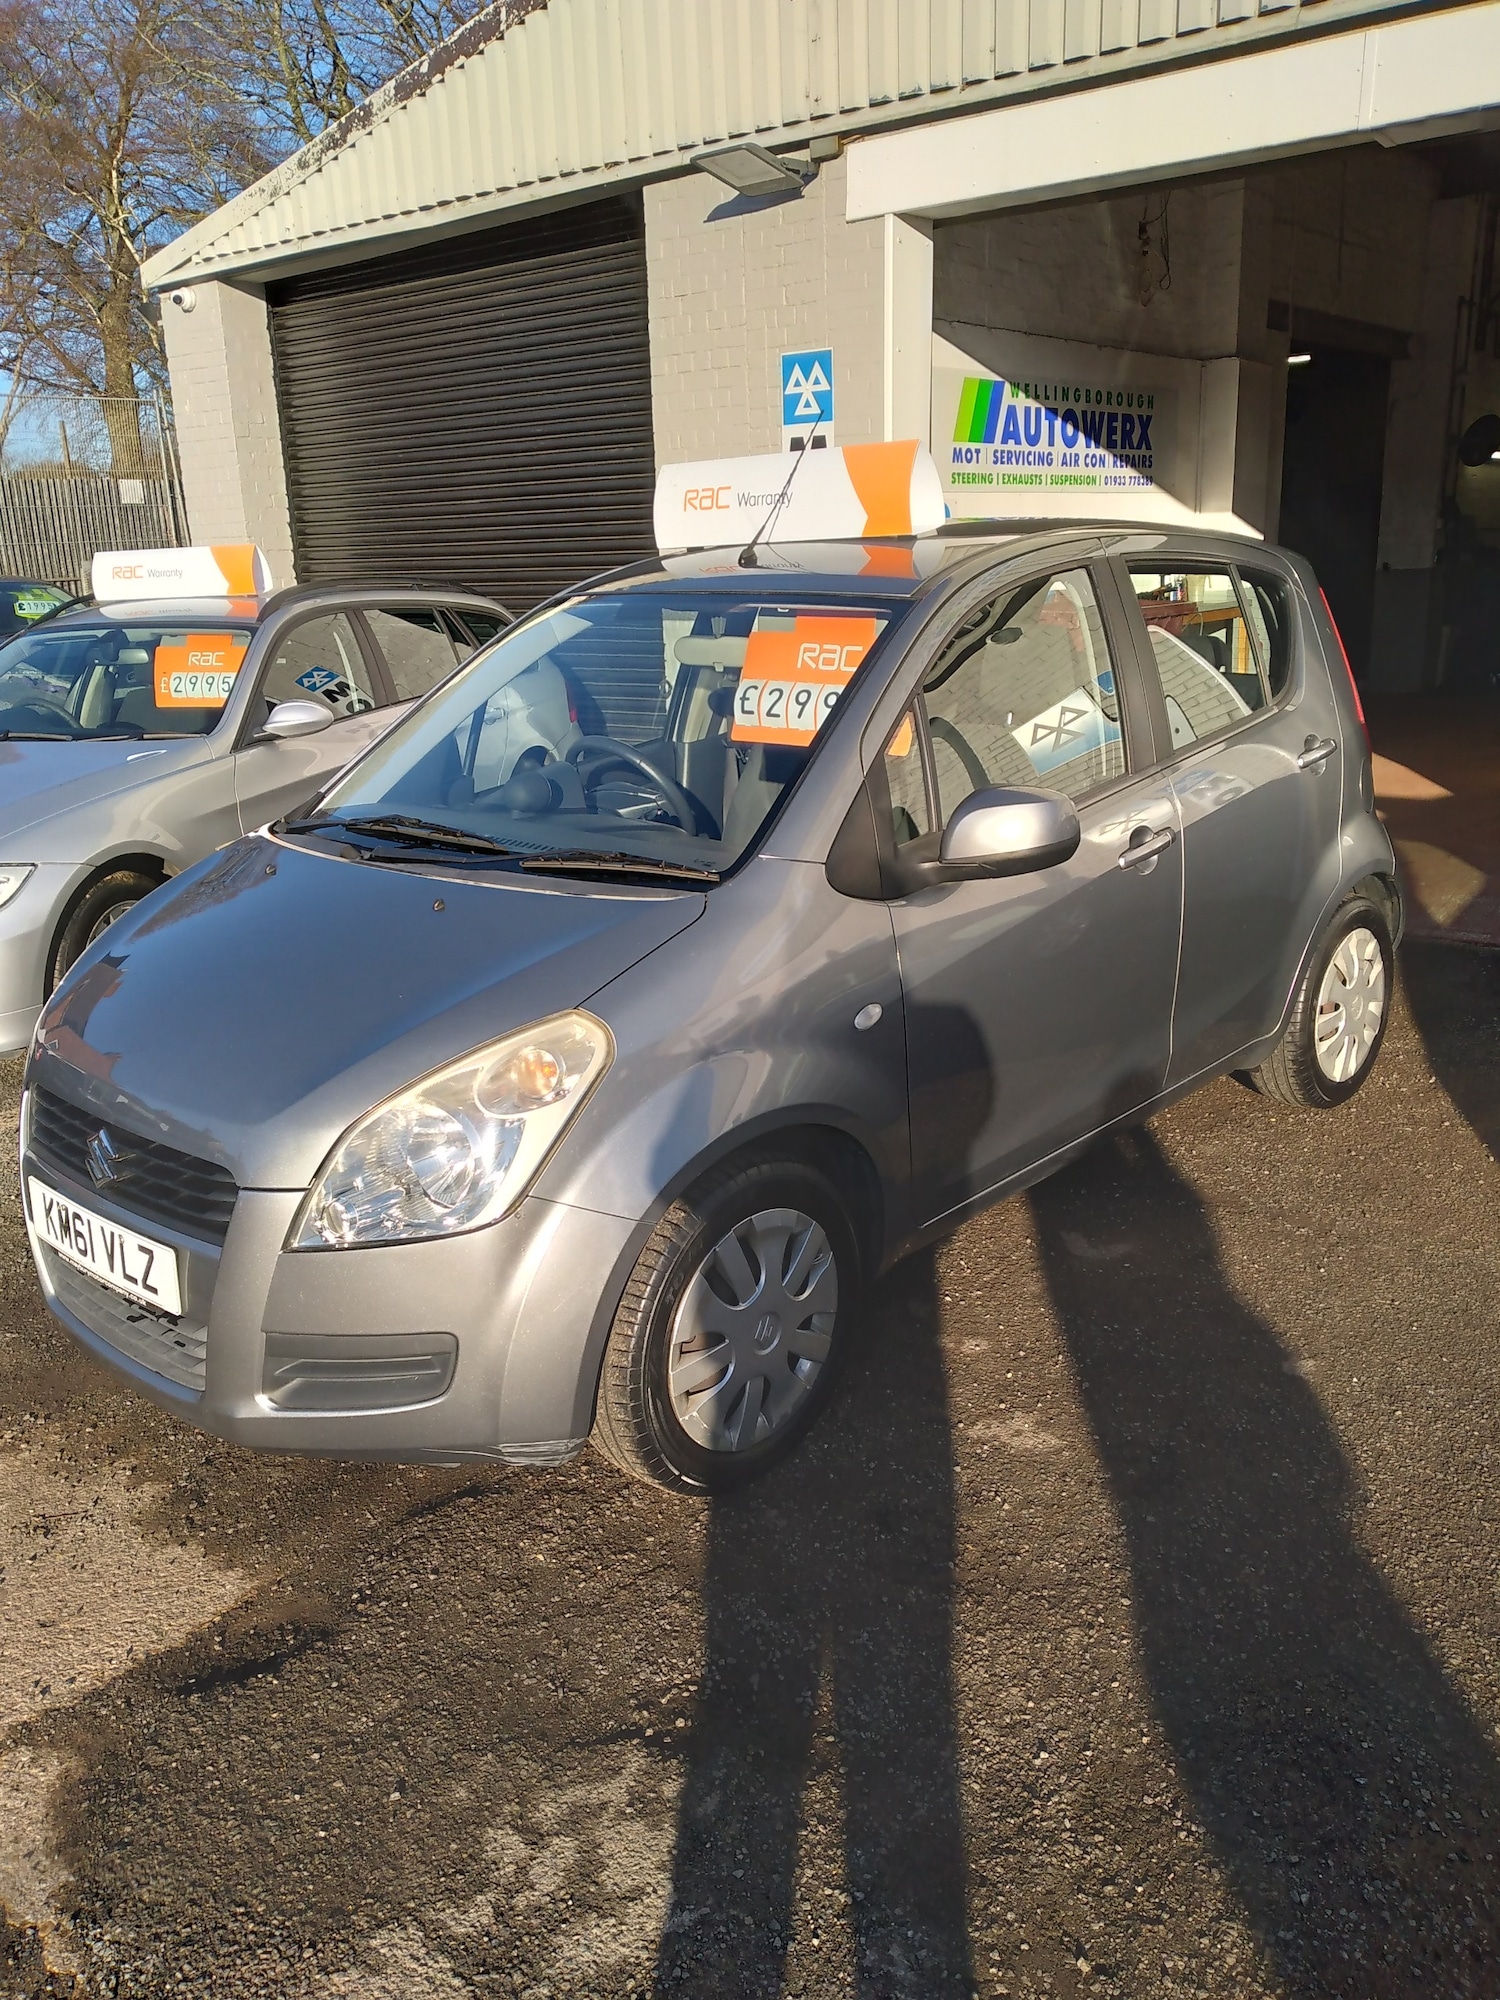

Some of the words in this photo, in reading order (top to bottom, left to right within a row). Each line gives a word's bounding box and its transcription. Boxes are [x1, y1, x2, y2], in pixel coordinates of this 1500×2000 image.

[1009, 382, 1154, 409] WELLINGBOROUGH
[1000, 404, 1153, 451] AUTOWERX
[952, 447, 981, 464] MOT
[992, 449, 1054, 467] SERVICING
[1061, 452, 1080, 468] AIR
[1084, 453, 1106, 468] CON
[1112, 454, 1153, 469] REPAIRS
[951, 472, 994, 485] STEERING
[1002, 473, 1043, 486] EXHAUSTS
[1049, 474, 1097, 486] SUSPENSION
[1104, 475, 1126, 486] 01933
[737, 490, 793, 509] Warranty
[147, 568, 183, 579] Warranty
[41, 1192, 96, 1264] KM61
[100, 1225, 159, 1297] VLZ
